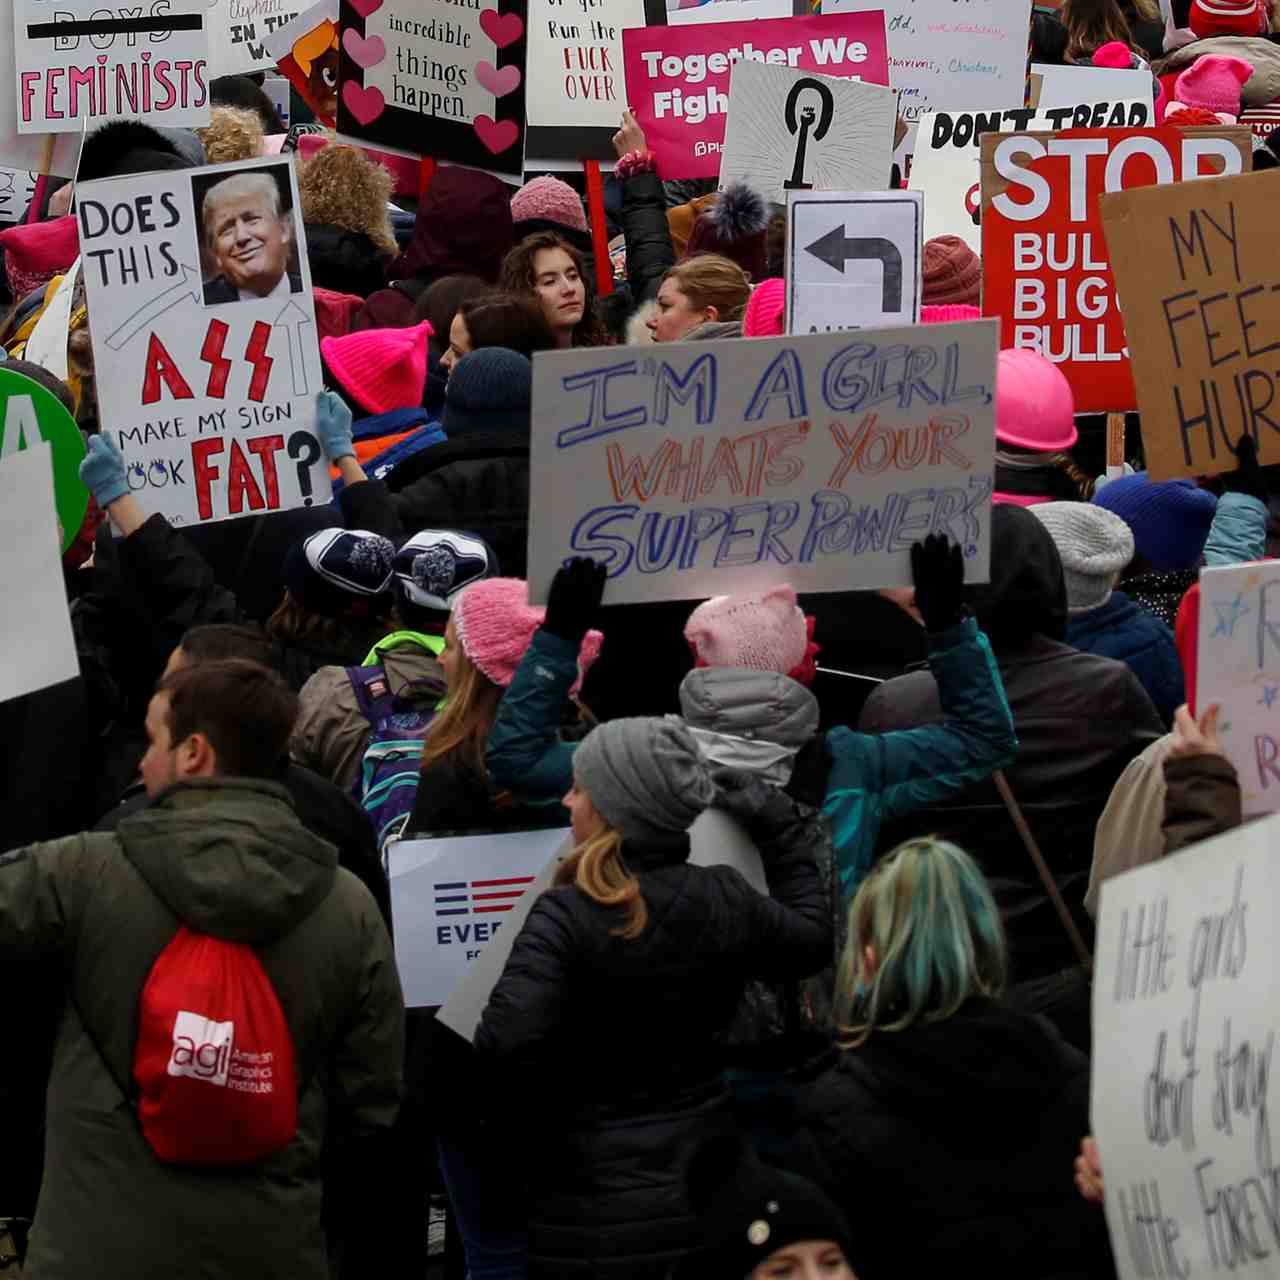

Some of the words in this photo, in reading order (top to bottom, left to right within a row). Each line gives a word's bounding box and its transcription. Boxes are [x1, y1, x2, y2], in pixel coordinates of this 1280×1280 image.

[230, 21, 255, 43] IN
[388, 11, 472, 49] incredible
[548, 21, 580, 39] Run
[589, 21, 615, 41] the
[396, 50, 467, 91] things
[564, 46, 614, 72] FUCK
[640, 42, 803, 82] Together
[810, 36, 869, 67] We
[21, 52, 207, 123] FEMINISTS
[565, 75, 617, 102] OVER
[930, 107, 1037, 149] DON'T
[991, 134, 1243, 223] STOP
[79, 190, 181, 241] DOES
[87, 240, 179, 288] THIS
[1168, 200, 1241, 283] MY
[556, 352, 718, 449] I'M
[744, 348, 809, 422] A
[119, 415, 186, 451] MAKE
[197, 410, 227, 432] MY
[237, 400, 292, 427] SIGN
[191, 429, 321, 520] FAT?
[828, 414, 973, 489] YOUR
